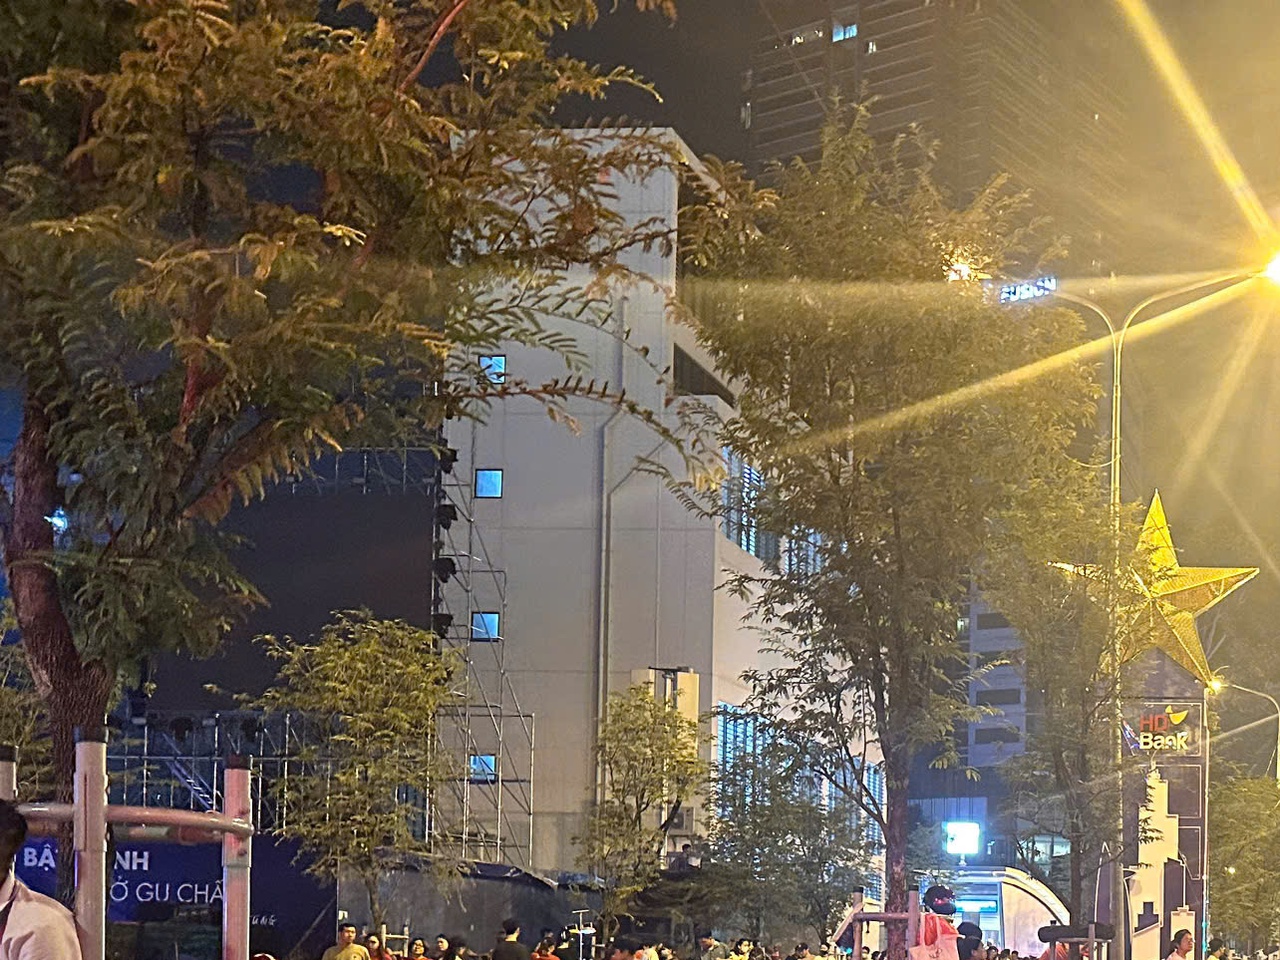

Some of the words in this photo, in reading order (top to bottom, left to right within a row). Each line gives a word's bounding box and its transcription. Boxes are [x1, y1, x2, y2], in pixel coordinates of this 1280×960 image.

[1140, 714, 1168, 732] HD
[1139, 731, 1189, 751] Bank
[23, 843, 57, 871] BẬ
[113, 850, 149, 871] NH
[135, 882, 170, 902] GU
[176, 879, 224, 904] CHẤ
